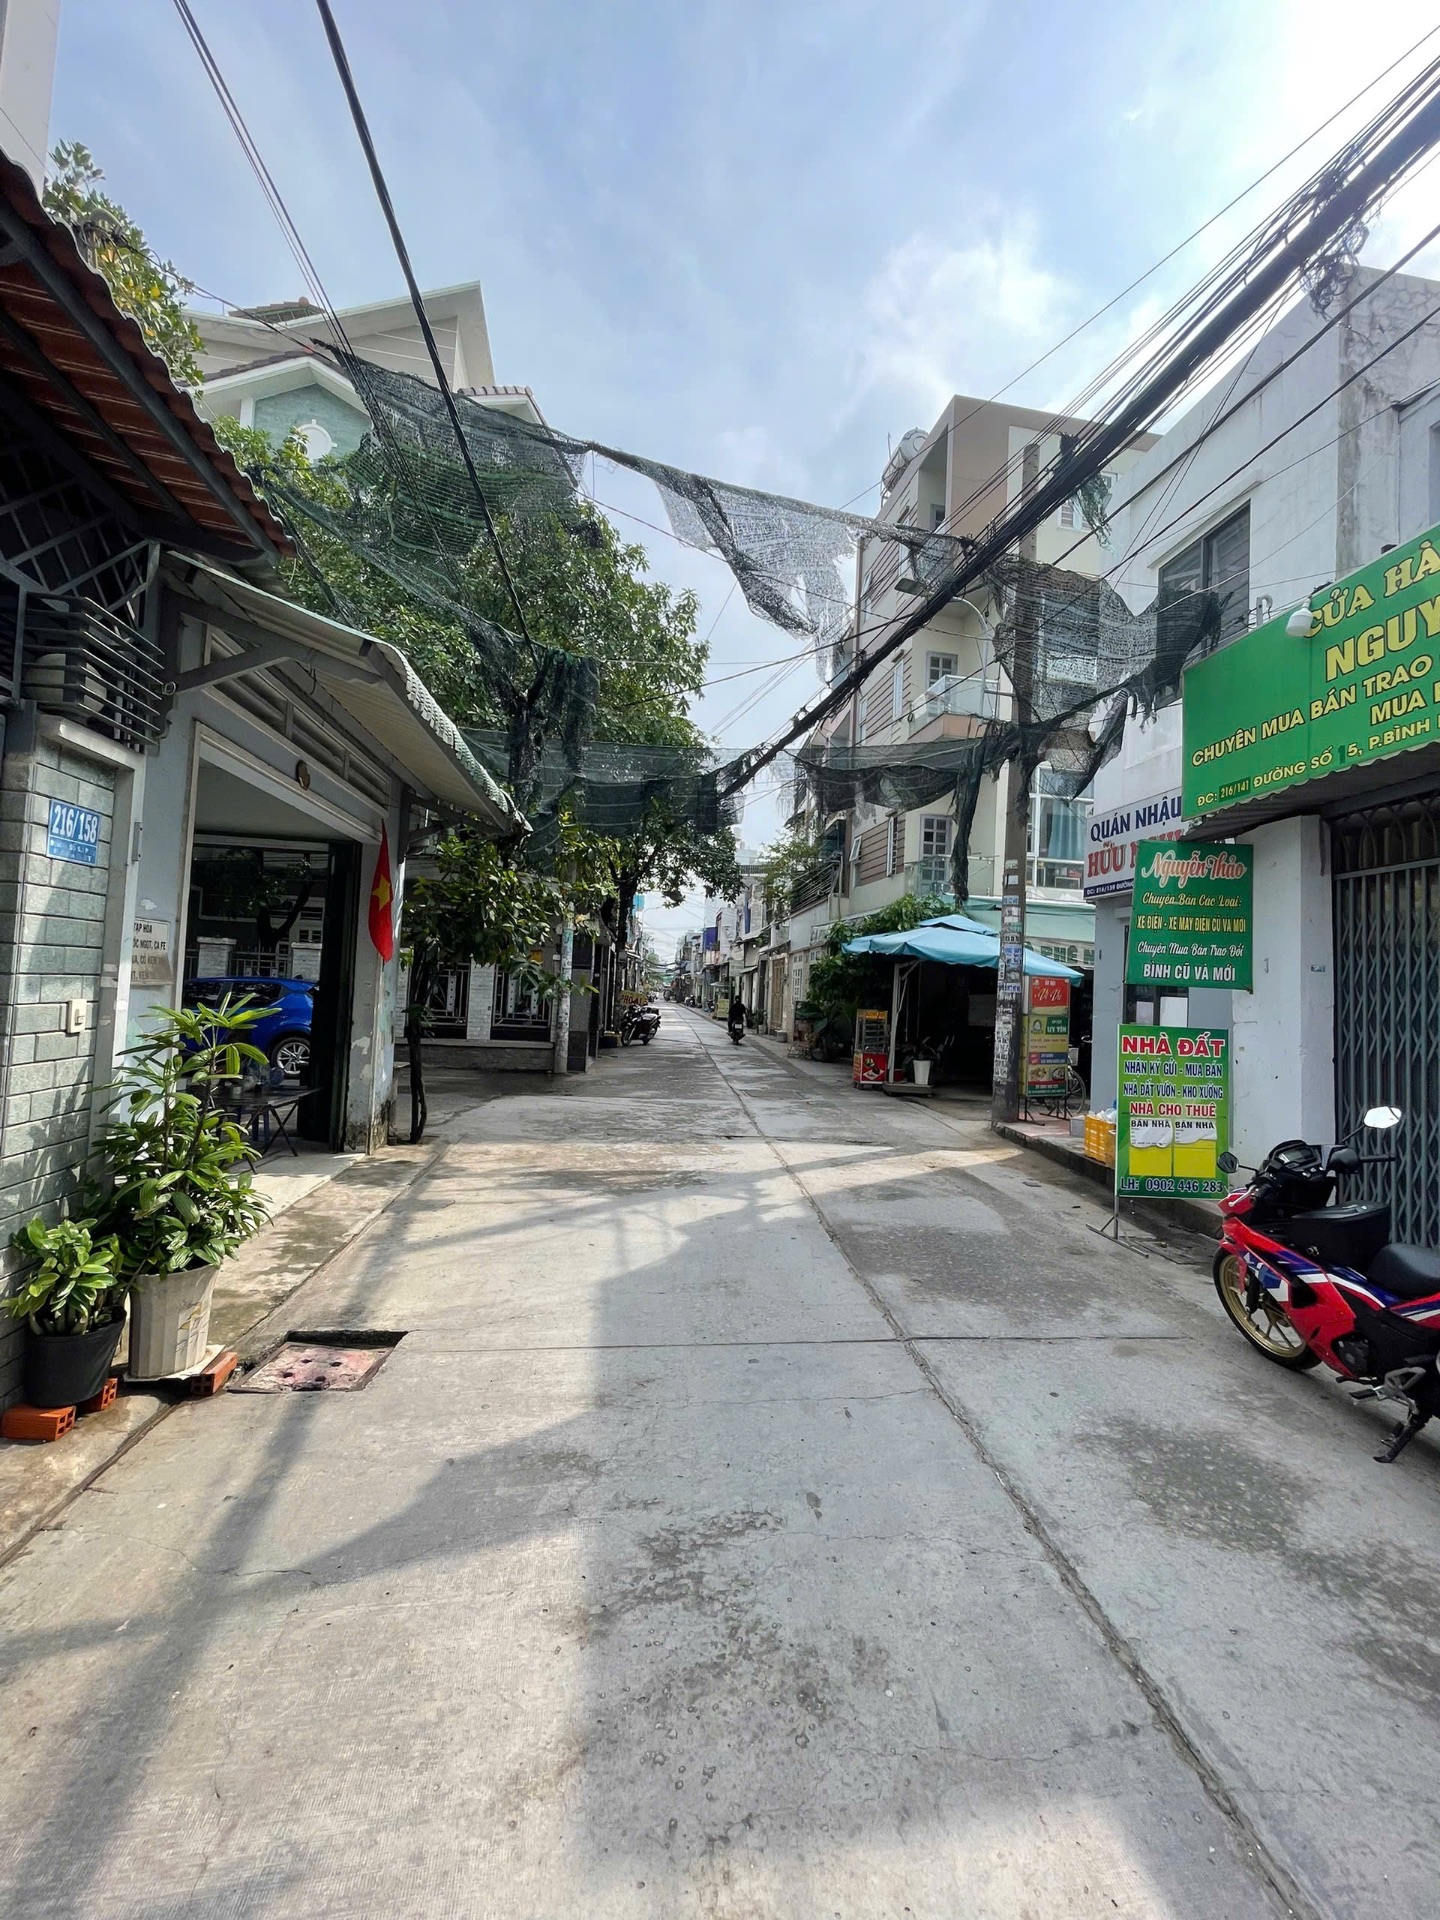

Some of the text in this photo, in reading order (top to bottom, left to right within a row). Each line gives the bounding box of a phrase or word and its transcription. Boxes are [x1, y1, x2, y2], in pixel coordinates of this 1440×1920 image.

[1192, 726, 1257, 767] CHUYÊN
[1261, 709, 1304, 739] MUA
[1310, 684, 1357, 721] BÁN
[1363, 655, 1433, 698] TRAO
[1370, 688, 1427, 726] MUA
[1197, 792, 1217, 807] ĐC:
[1220, 779, 1250, 799] 216/141
[1253, 758, 1306, 788] ĐƯỜNG
[1311, 746, 1333, 770] SỐ
[1369, 718, 1430, 750] P.BÌNH
[51, 804, 98, 844] 216/158
[1090, 811, 1131, 842] QUÁN
[1135, 795, 1182, 829] NHẬU
[1087, 840, 1127, 877] HỮU
[1141, 849, 1207, 888] Nguyễn
[1205, 851, 1247, 882] Thảo
[1142, 892, 1175, 910] Chuyên
[1178, 893, 1197, 906] Bán
[1199, 894, 1214, 906] Các
[1137, 915, 1147, 929] XE
[1147, 913, 1162, 933] ĐIỆN
[1169, 917, 1178, 930] XE
[1179, 914, 1193, 931] MÁY
[1195, 915, 1210, 933] ĐIỆN
[1137, 941, 1166, 957] Chuyên
[1169, 942, 1188, 955] Mua
[1191, 942, 1207, 955] Bán
[1210, 943, 1227, 956] Trao
[1143, 961, 1236, 981] BÌNH CŨ VÀ MỚI
[1122, 1031, 1225, 1057] NHÀ ĐẤT
[1124, 1058, 1147, 1077] NHẬN
[1149, 1058, 1161, 1075] KÝ
[1163, 1057, 1177, 1075] GỬI
[1185, 1063, 1203, 1076] MUA
[1205, 1060, 1223, 1077] BÁN
[1123, 1080, 1137, 1096] NHÀ
[1140, 1078, 1154, 1097] ĐẤT
[1157, 1080, 1176, 1097] VƯỜN
[1182, 1085, 1197, 1097] KHO
[1199, 1081, 1223, 1099] XƯỞNG
[1130, 1099, 1216, 1117] NHÀ CHO THUÊ
[1175, 1119, 1193, 1129] BÁN
[1121, 1178, 1223, 1193] LH: 0902 446 283
